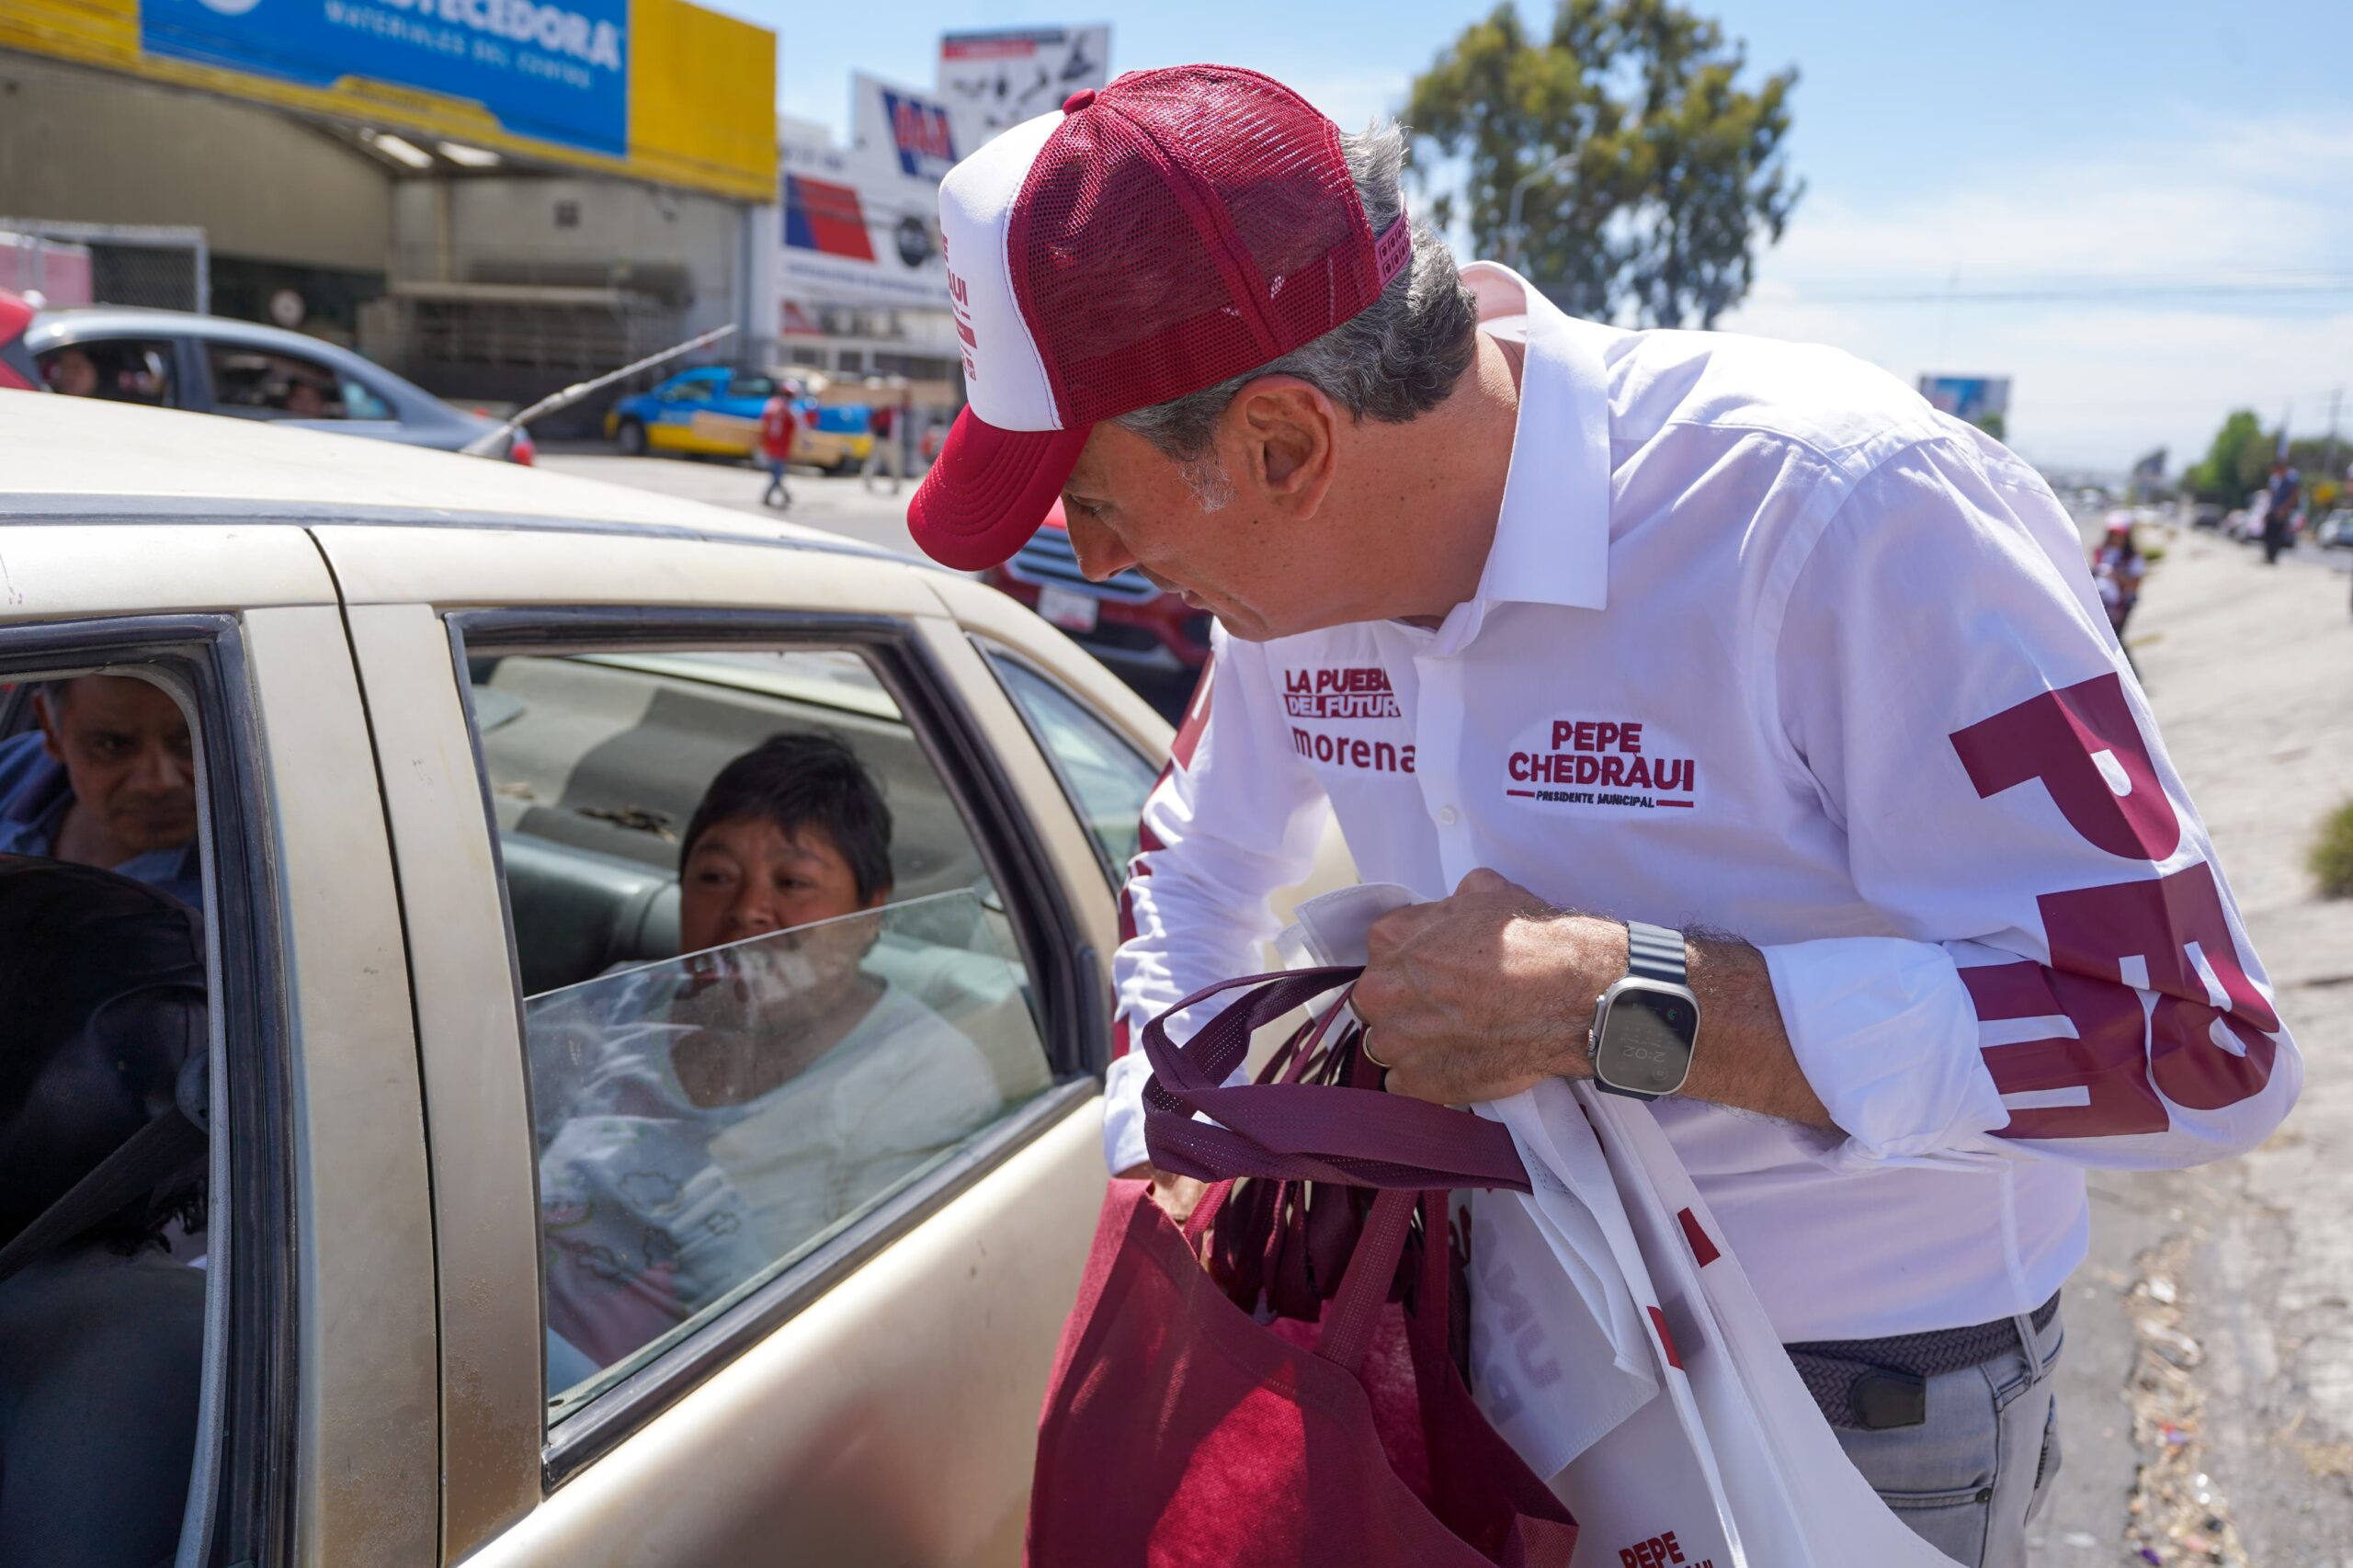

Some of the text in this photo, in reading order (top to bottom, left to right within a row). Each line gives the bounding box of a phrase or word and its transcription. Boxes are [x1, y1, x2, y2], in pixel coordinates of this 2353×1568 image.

[1285, 668, 1313, 694] LA
[1288, 695, 1323, 717] DEL
[1292, 726, 1416, 774] morena
[1552, 720, 1643, 754] PEPE
[1508, 751, 1695, 791] CHEDRAUI
[1536, 790, 1655, 809] PRESIDENTE MUNICIPAL
[1618, 1530, 1686, 1568] PEPE
